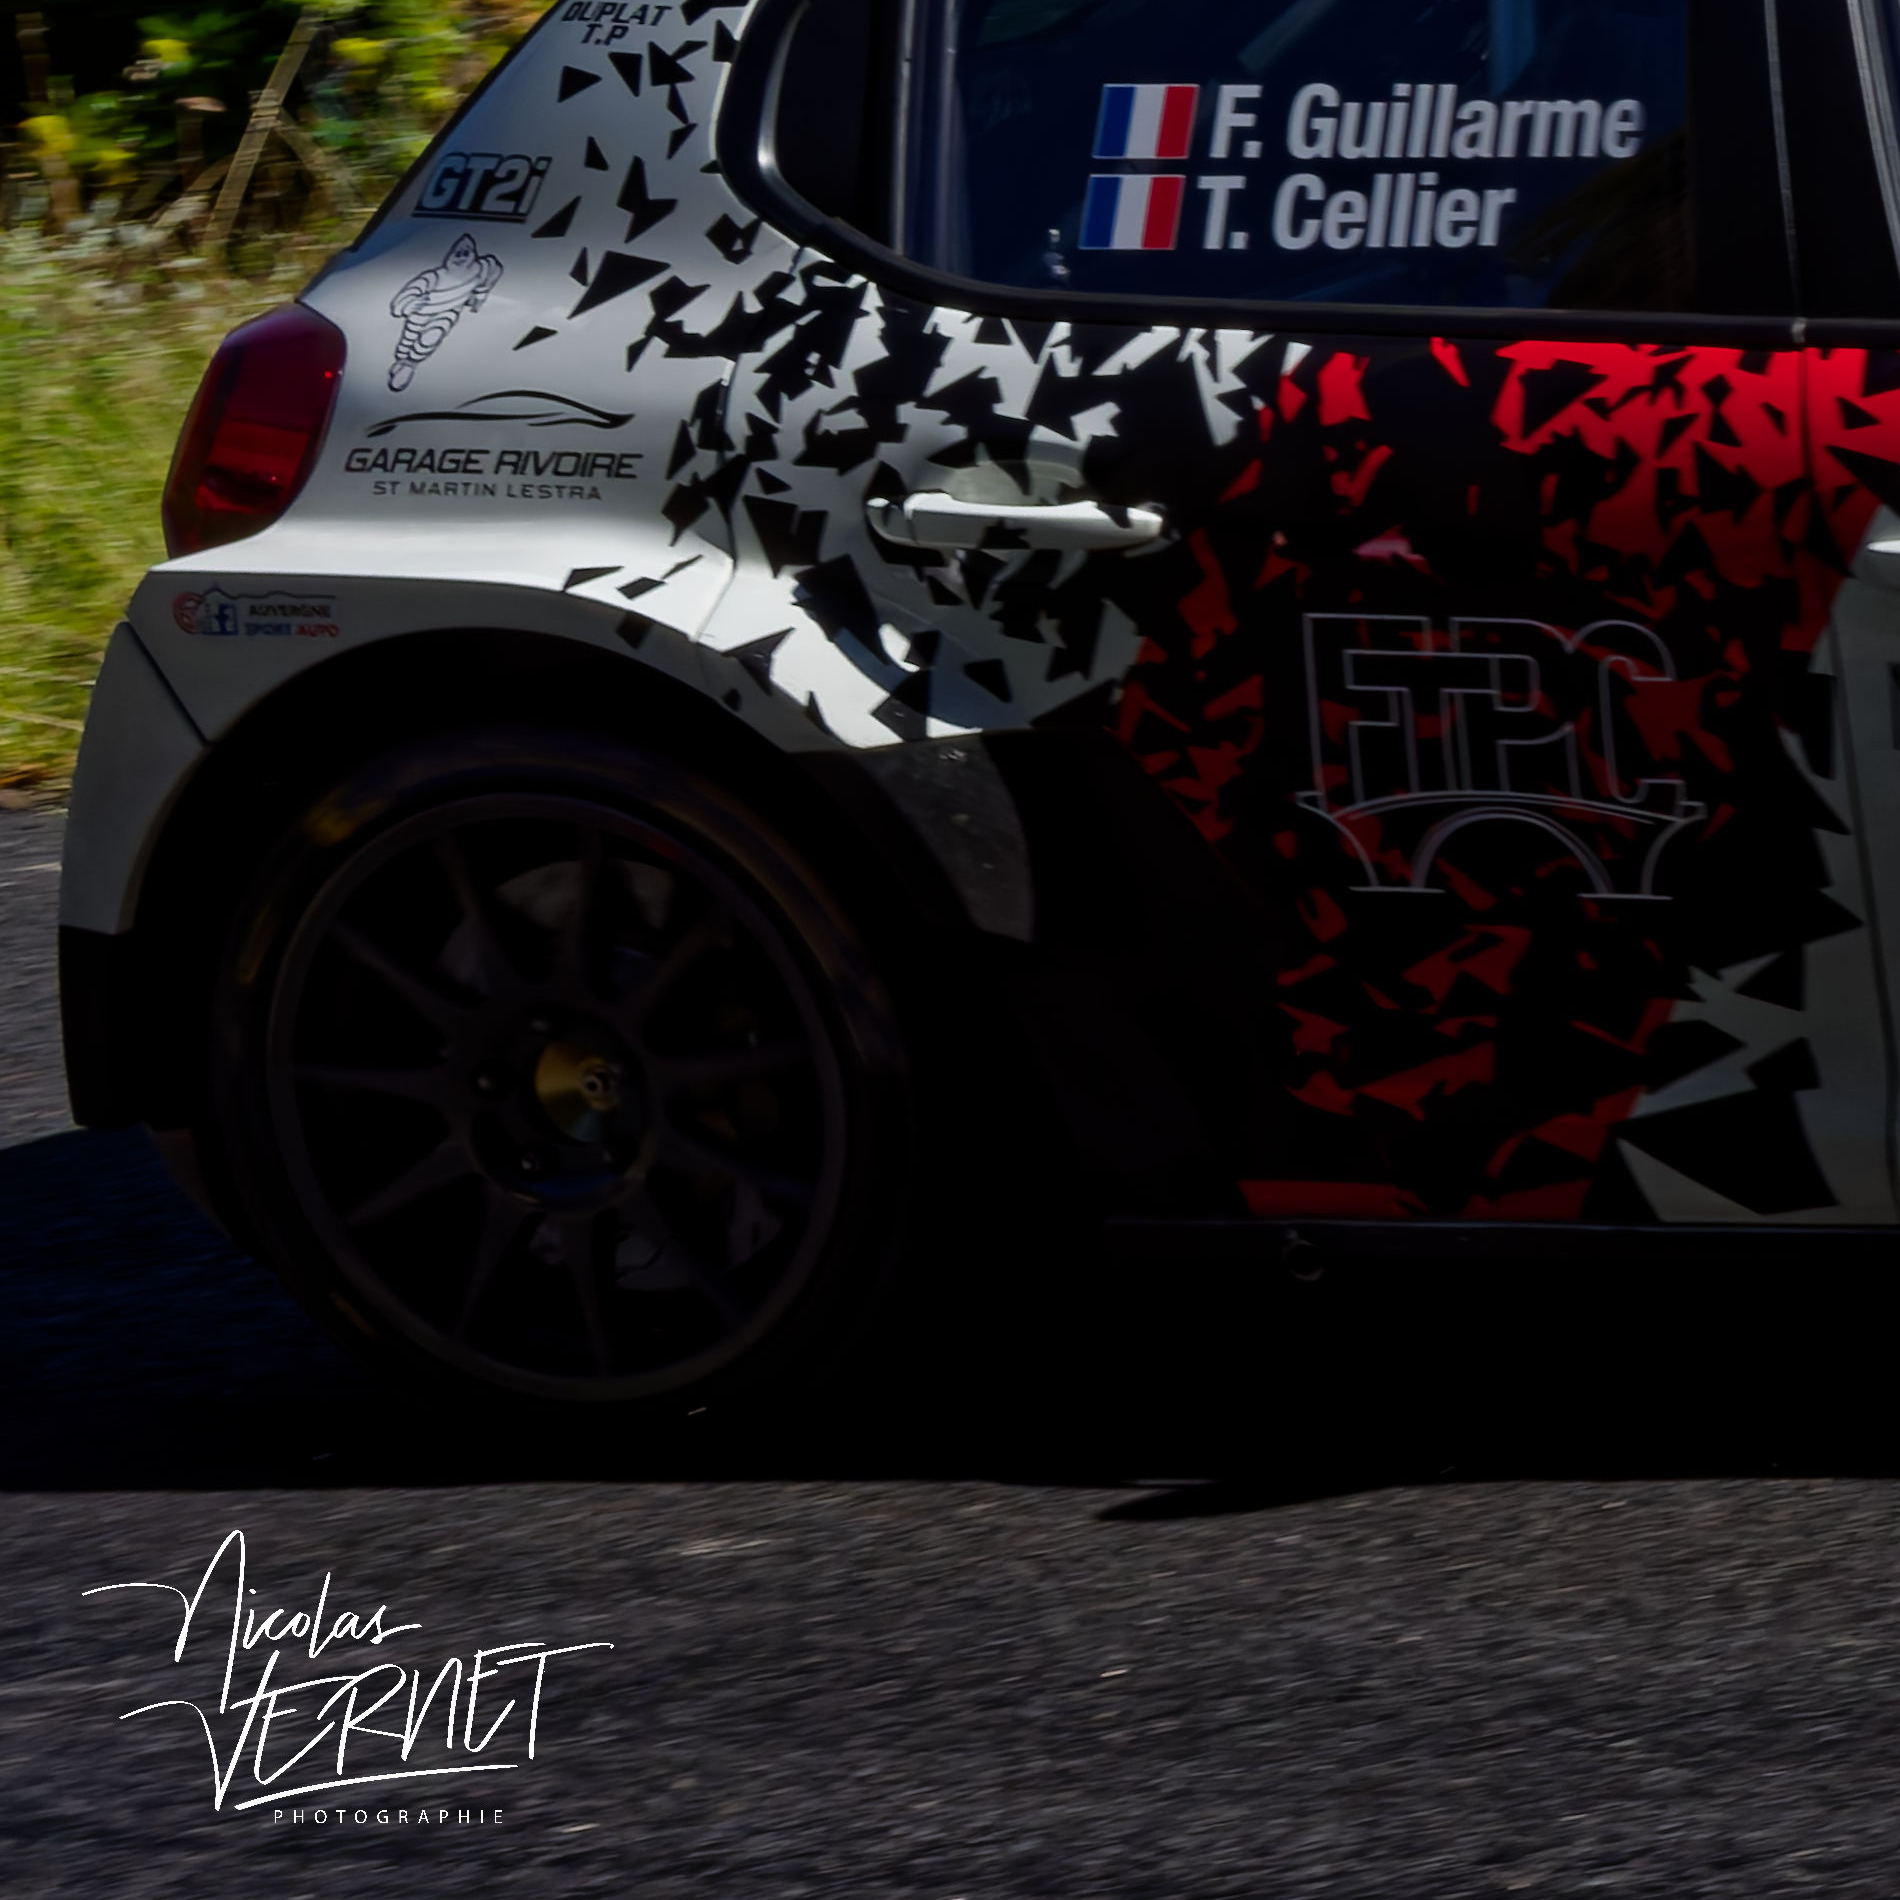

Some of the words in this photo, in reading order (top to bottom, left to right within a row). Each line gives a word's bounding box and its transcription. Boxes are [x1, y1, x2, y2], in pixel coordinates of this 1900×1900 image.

[580, 23, 630, 46] T.P
[1209, 84, 1263, 160] F.
[1286, 82, 1645, 161] Guillarme
[418, 153, 554, 214] GT2i
[1198, 174, 1249, 250] T.
[1272, 172, 1517, 250] Cellier
[344, 446, 491, 476] GARAGE
[493, 448, 643, 479] RIVOIRE
[372, 480, 402, 497] ST
[408, 481, 497, 498] MARTIN
[505, 483, 601, 500] LESTRA
